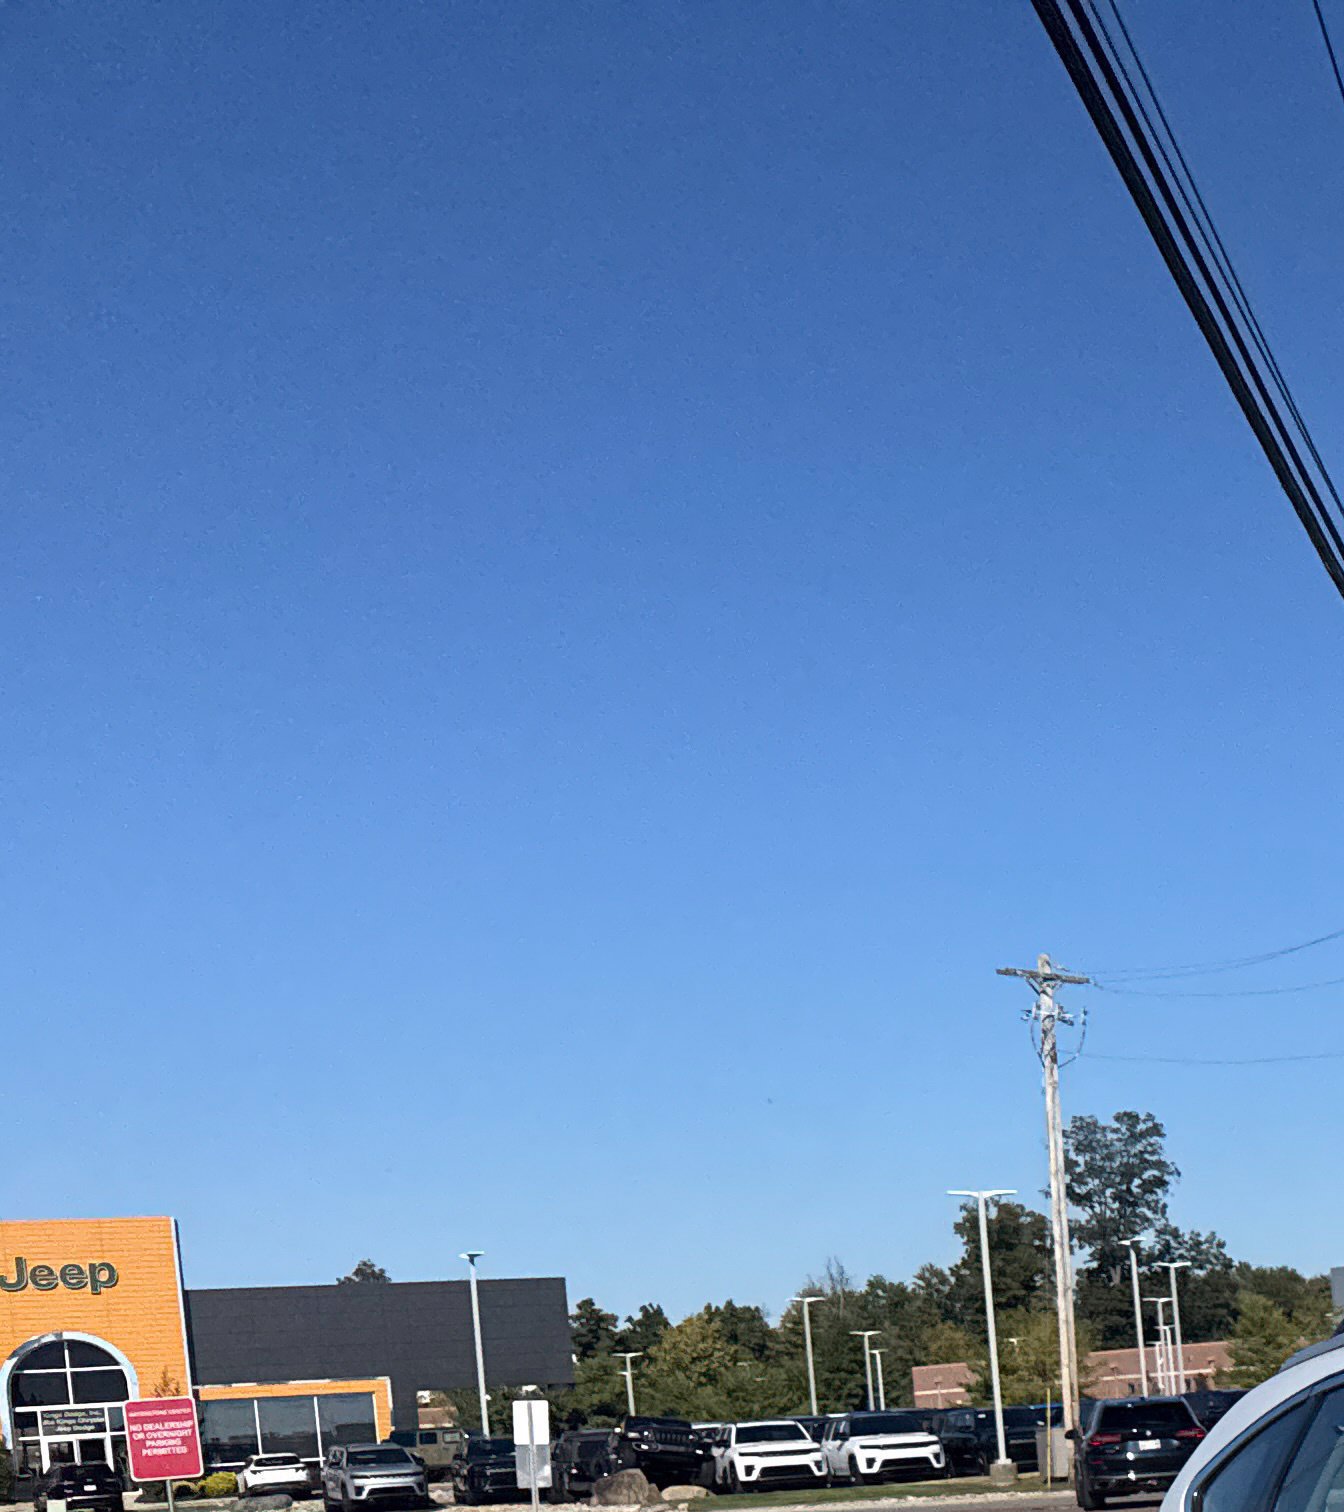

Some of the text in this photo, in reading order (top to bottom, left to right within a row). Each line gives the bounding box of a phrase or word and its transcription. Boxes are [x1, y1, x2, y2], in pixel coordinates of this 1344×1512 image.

[0, 1256, 119, 1295] Jeep
[129, 1420, 194, 1433] NO DEALERSHIP
[132, 1428, 192, 1440] OR OVERNIGHT
[145, 1437, 182, 1447] PARKING
[141, 1445, 188, 1456] PERMITTED
